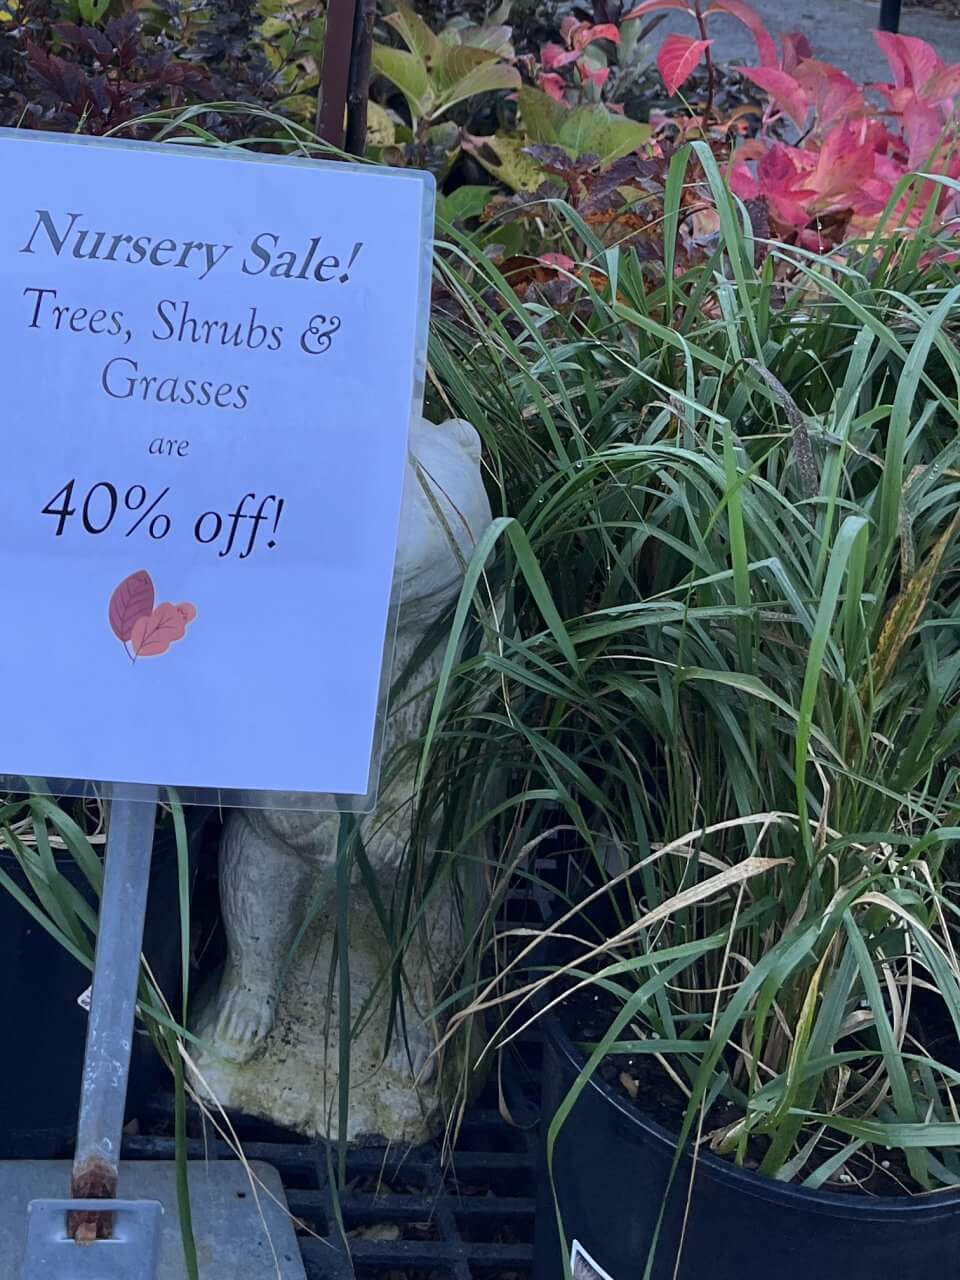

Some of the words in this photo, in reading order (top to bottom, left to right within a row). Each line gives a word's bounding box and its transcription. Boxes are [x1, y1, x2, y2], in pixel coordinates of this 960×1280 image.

[19, 209, 233, 280] Nursery
[241, 232, 363, 284] Sale!
[23, 287, 133, 345] Trees,
[151, 300, 284, 351] Shrubs
[300, 314, 342, 355] &
[101, 357, 250, 410] Grasses
[148, 437, 190, 457] are
[41, 478, 172, 540] 40%
[194, 493, 285, 560] off!
